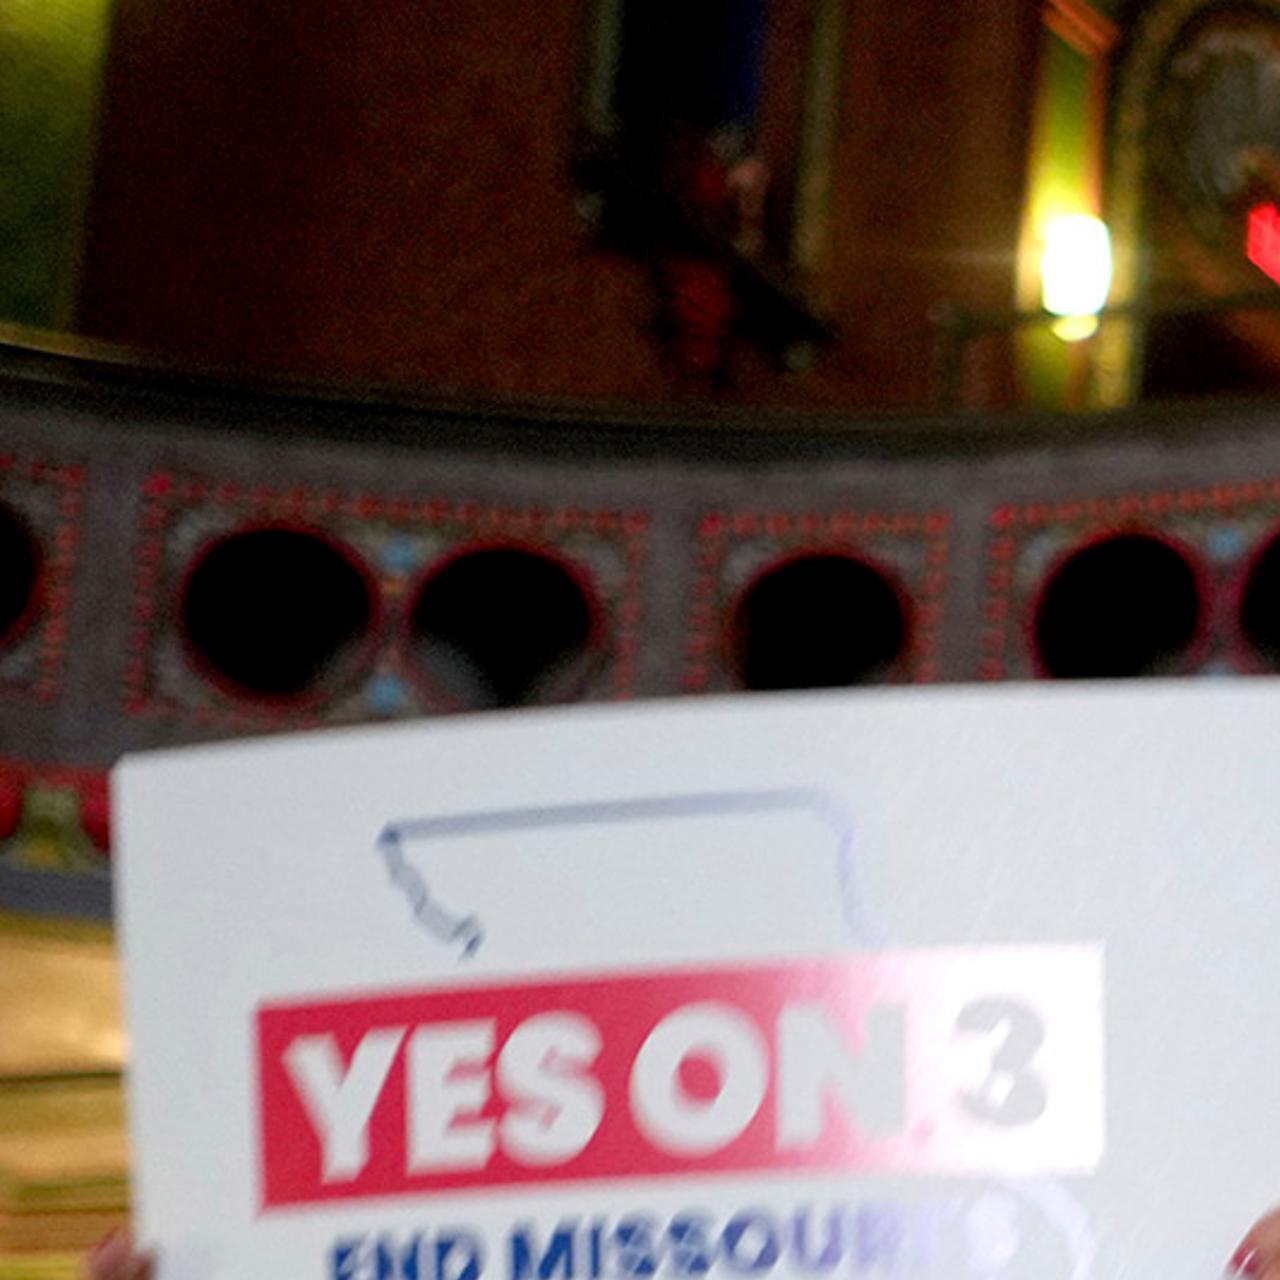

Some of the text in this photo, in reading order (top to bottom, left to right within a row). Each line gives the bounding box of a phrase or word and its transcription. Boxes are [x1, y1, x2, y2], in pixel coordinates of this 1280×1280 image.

[281, 996, 1048, 1184] YES ON 3
